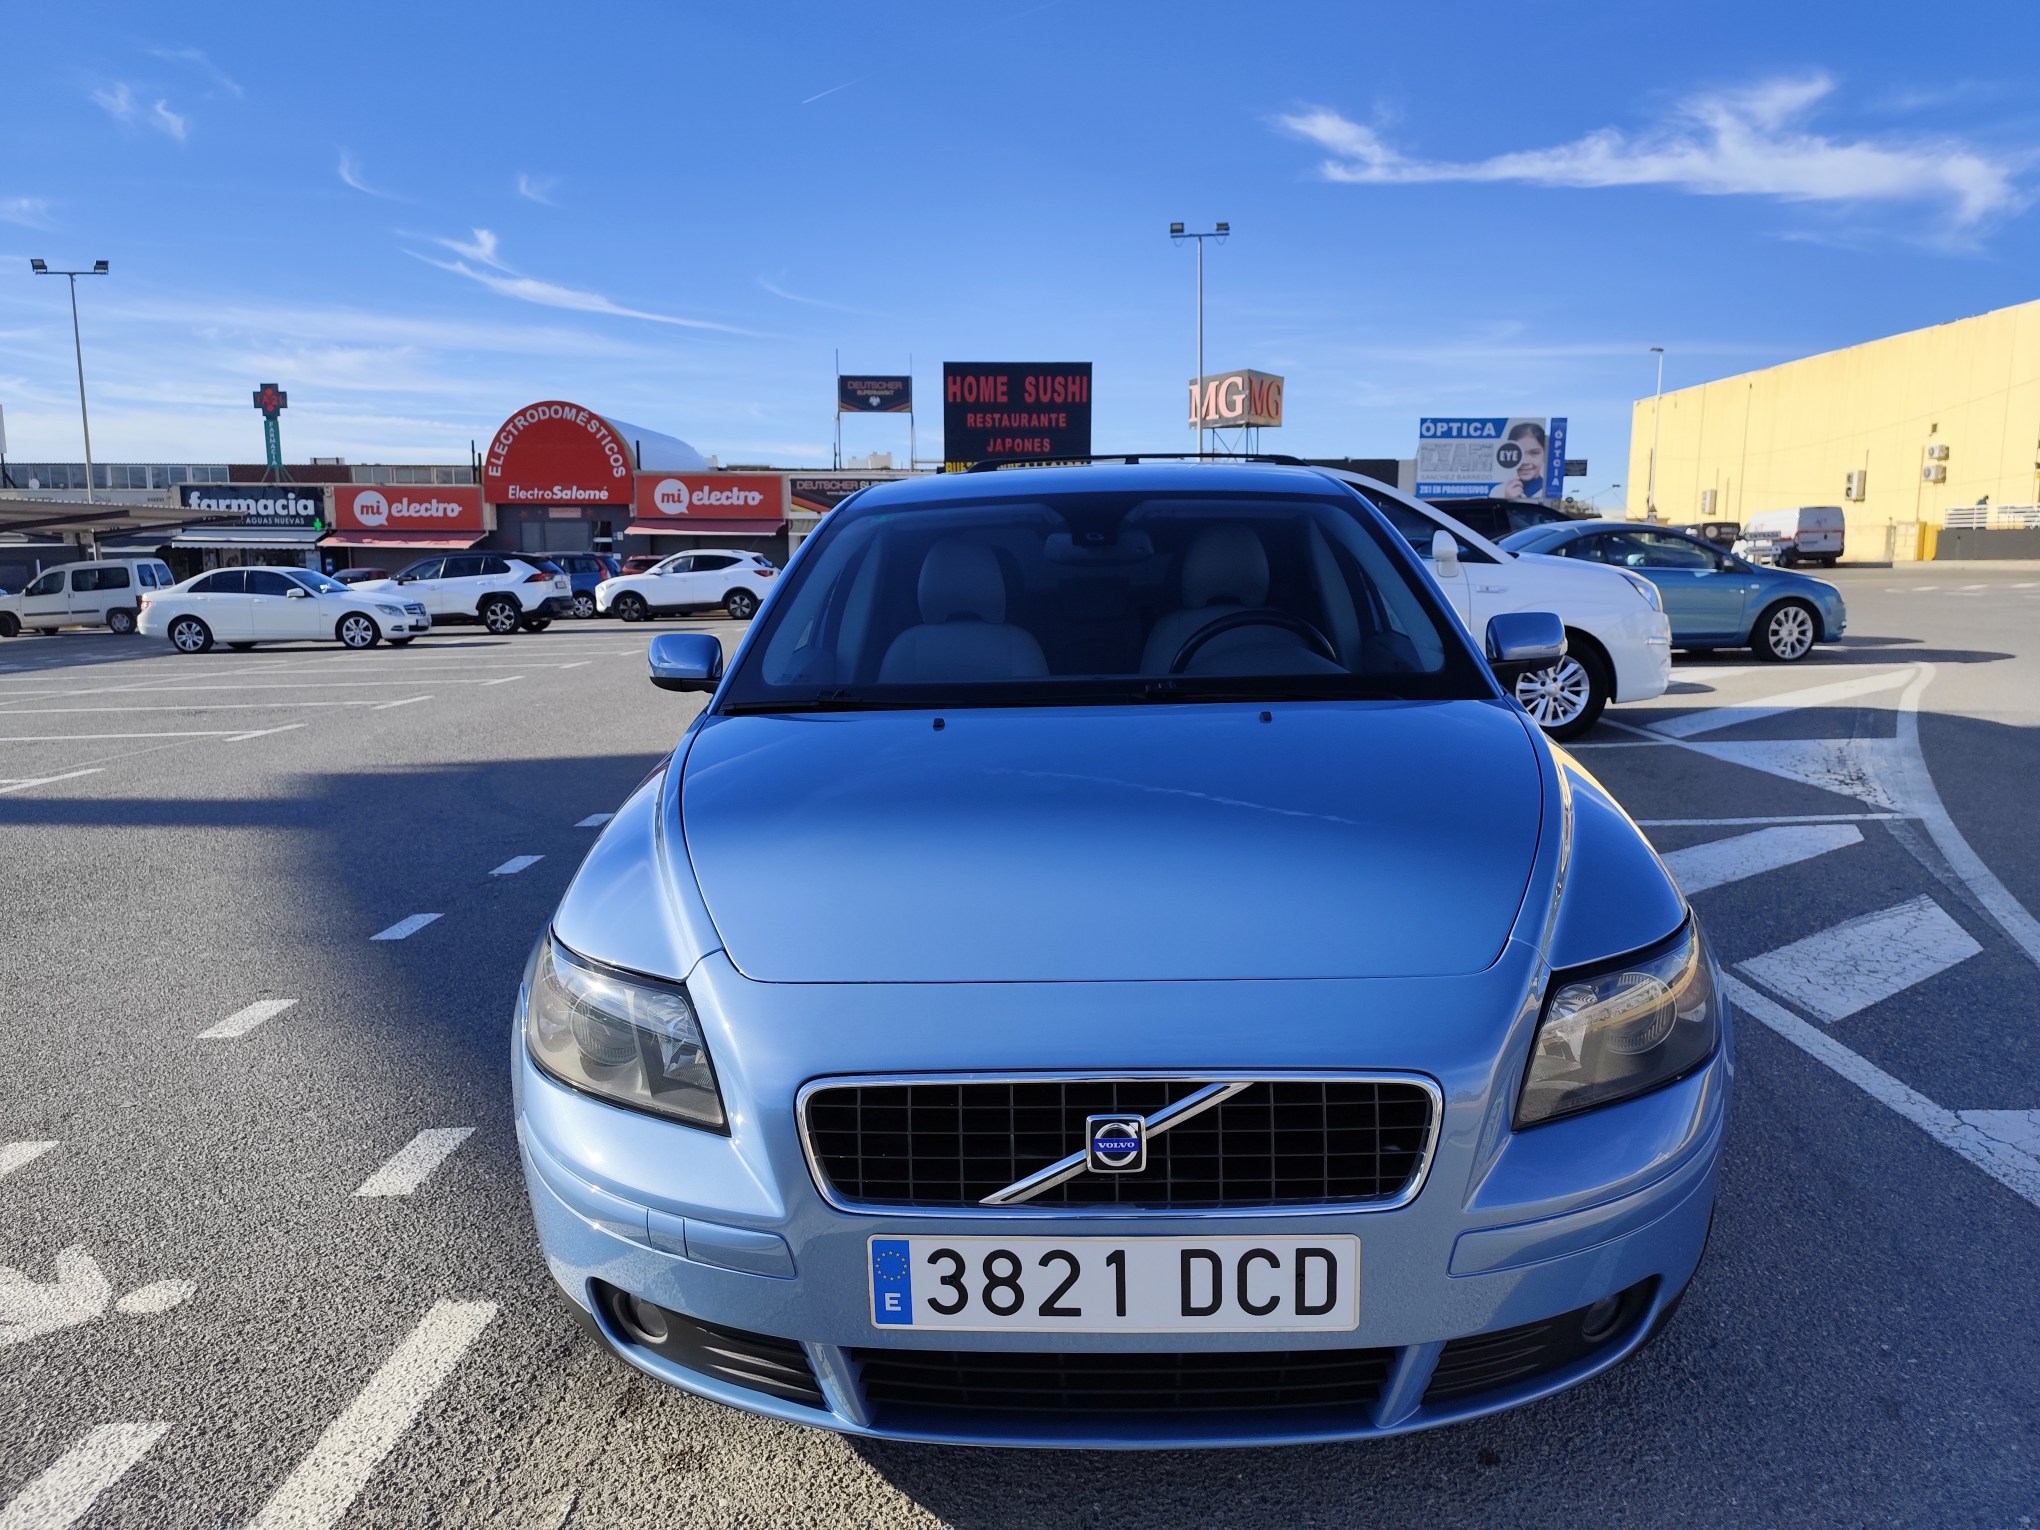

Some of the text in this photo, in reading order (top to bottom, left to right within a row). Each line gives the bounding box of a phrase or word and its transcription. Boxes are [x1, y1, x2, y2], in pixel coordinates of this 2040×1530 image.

[947, 375, 1087, 403] HOME SUSHI
[1248, 374, 1281, 420] MG
[1189, 376, 1246, 422] MG
[966, 413, 1067, 428] RESTAURANTE
[1421, 419, 1496, 436] ÓPTICA
[488, 405, 626, 478] ELECTRODOMÉSTICOS
[986, 438, 1051, 453] JAPONES
[1500, 449, 1519, 462] EYE
[508, 485, 608, 500] ElectroSalomé
[796, 480, 858, 490] DEUTSCHER
[189, 491, 315, 516] farmacia
[660, 485, 763, 506] mi electro
[360, 497, 462, 517] mi electro
[245, 516, 273, 525] AGUAS
[274, 517, 305, 525] NUEVAS
[927, 1247, 1338, 1317] 3821 DCD
[884, 1292, 902, 1311] E
